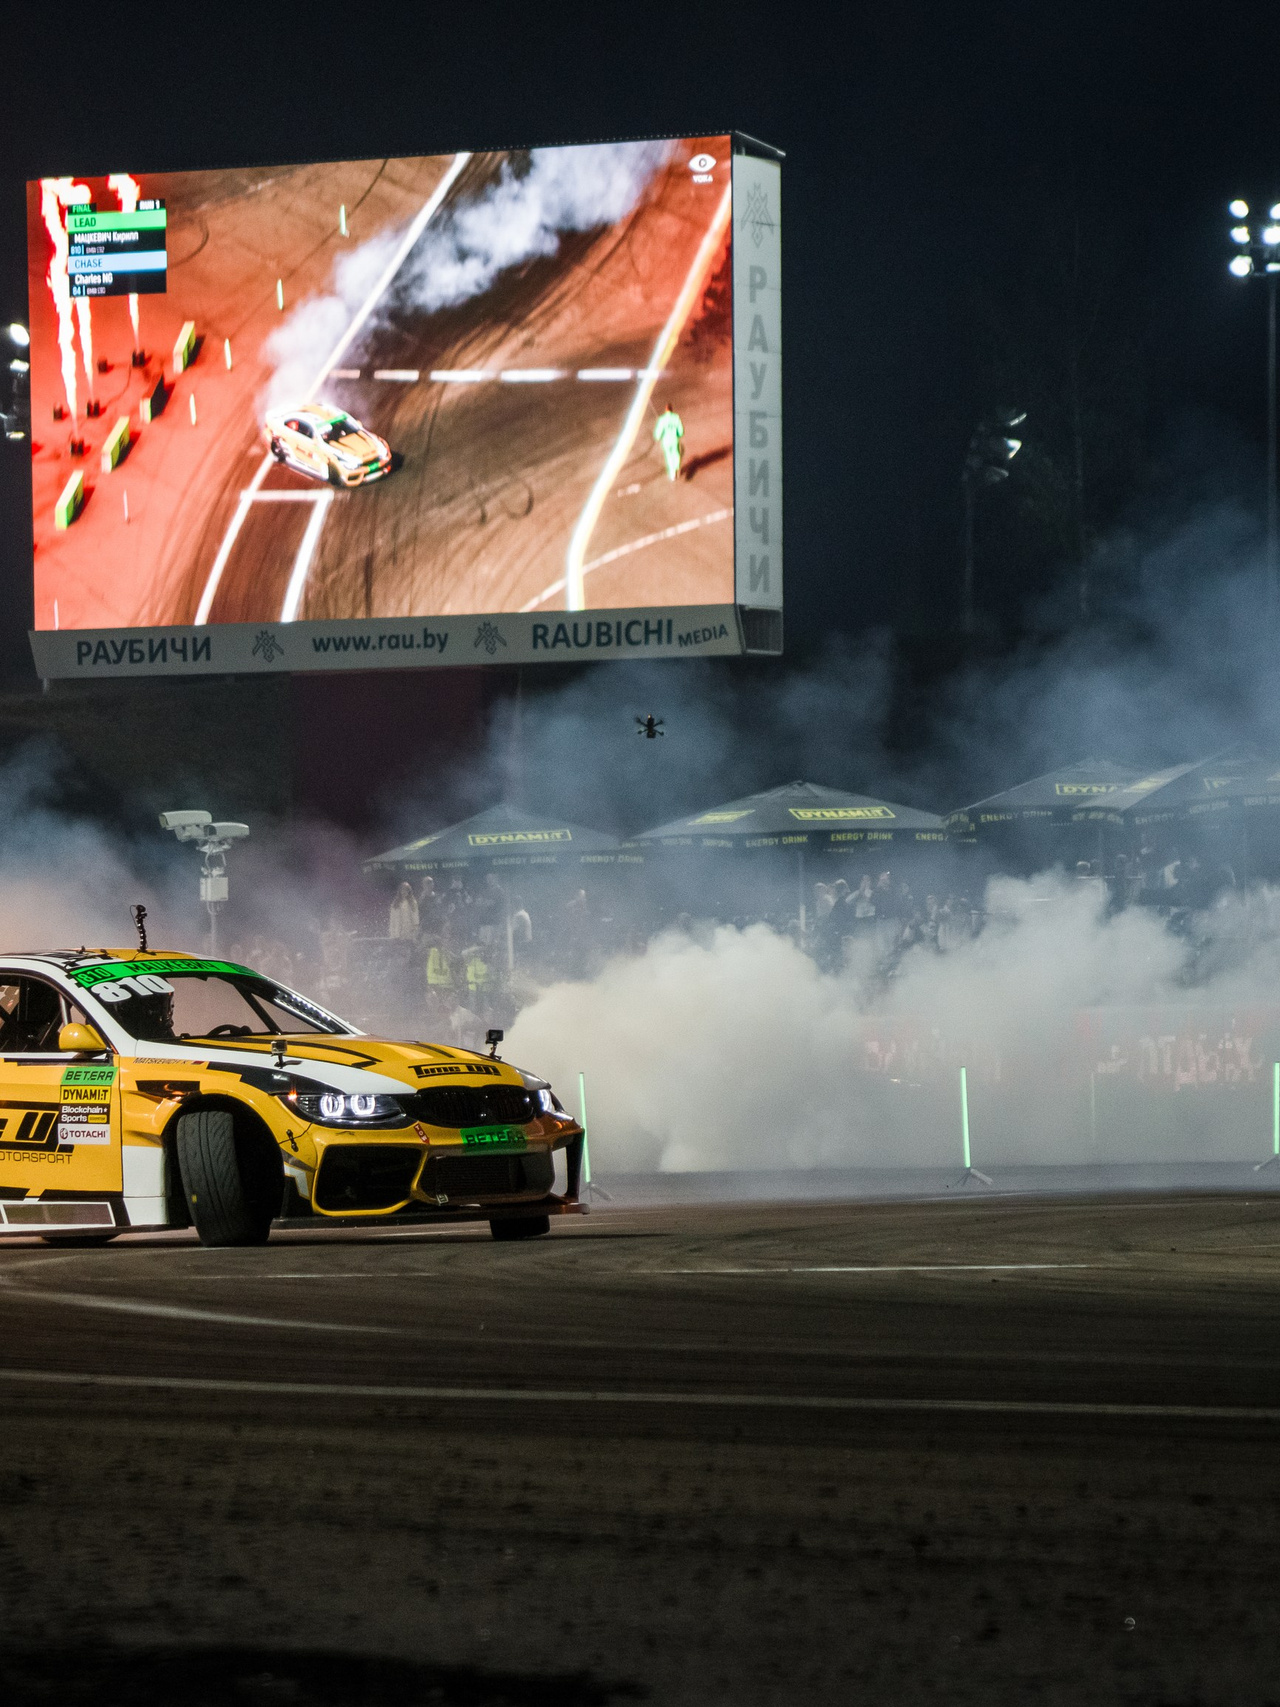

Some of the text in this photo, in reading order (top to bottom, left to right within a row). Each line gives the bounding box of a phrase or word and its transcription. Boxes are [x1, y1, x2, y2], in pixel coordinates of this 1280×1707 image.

[72, 204, 91, 213] FINAL
[74, 217, 96, 228] LEAD
[74, 232, 111, 244] МАЦКЕВИЧ
[75, 258, 102, 269] CHASE
[74, 271, 101, 285] Charles
[747, 265, 769, 593] РАУБИЧИ
[312, 627, 449, 654] www.rau.by
[531, 619, 729, 650] RAUBICHI MEDIA
[76, 636, 212, 666] РАУБИЧИ
[830, 832, 893, 842] ENERGY DRINK
[124, 960, 217, 974] МАЦКЕВИЧ
[80, 967, 112, 983] 810
[91, 974, 175, 1002] 810
[61, 1105, 103, 1114] Blockchain
[61, 1114, 87, 1123] Sports
[70, 1130, 106, 1138] TOTACHI
